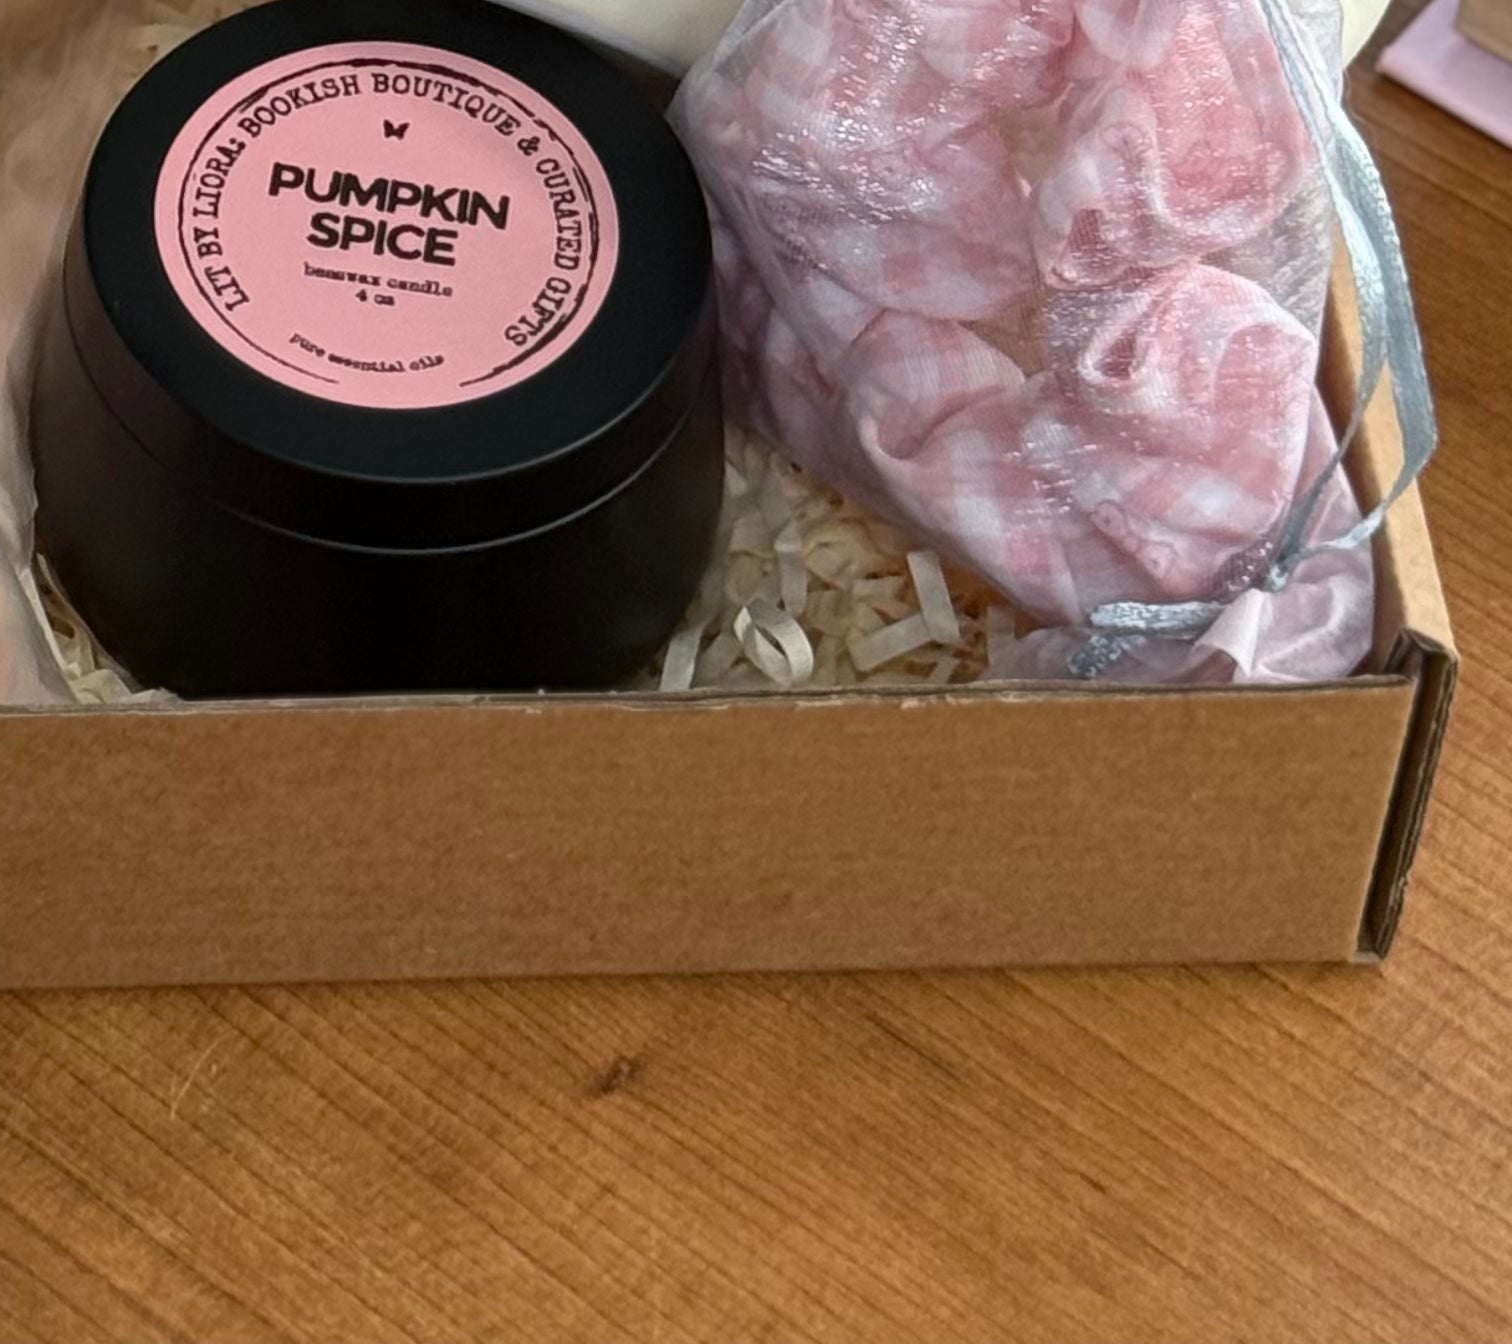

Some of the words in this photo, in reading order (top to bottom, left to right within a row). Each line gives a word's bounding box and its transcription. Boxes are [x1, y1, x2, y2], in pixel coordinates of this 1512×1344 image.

[238, 73, 361, 139] BOOKISH
[371, 72, 522, 137] BOUTIQUE
[517, 135, 541, 157] &
[192, 137, 247, 219] LIORA:
[268, 162, 511, 231] PUMPKIN
[306, 212, 459, 268] SPICE
[535, 157, 583, 271] CURATED
[193, 226, 223, 260] BY
[204, 265, 250, 312] LIT
[302, 260, 382, 288] beeswax
[386, 276, 454, 298] candle
[354, 288, 368, 303] 4
[503, 275, 572, 347] GIFTS
[288, 332, 326, 357] pure
[328, 352, 406, 374] essential
[409, 354, 445, 372] oils
